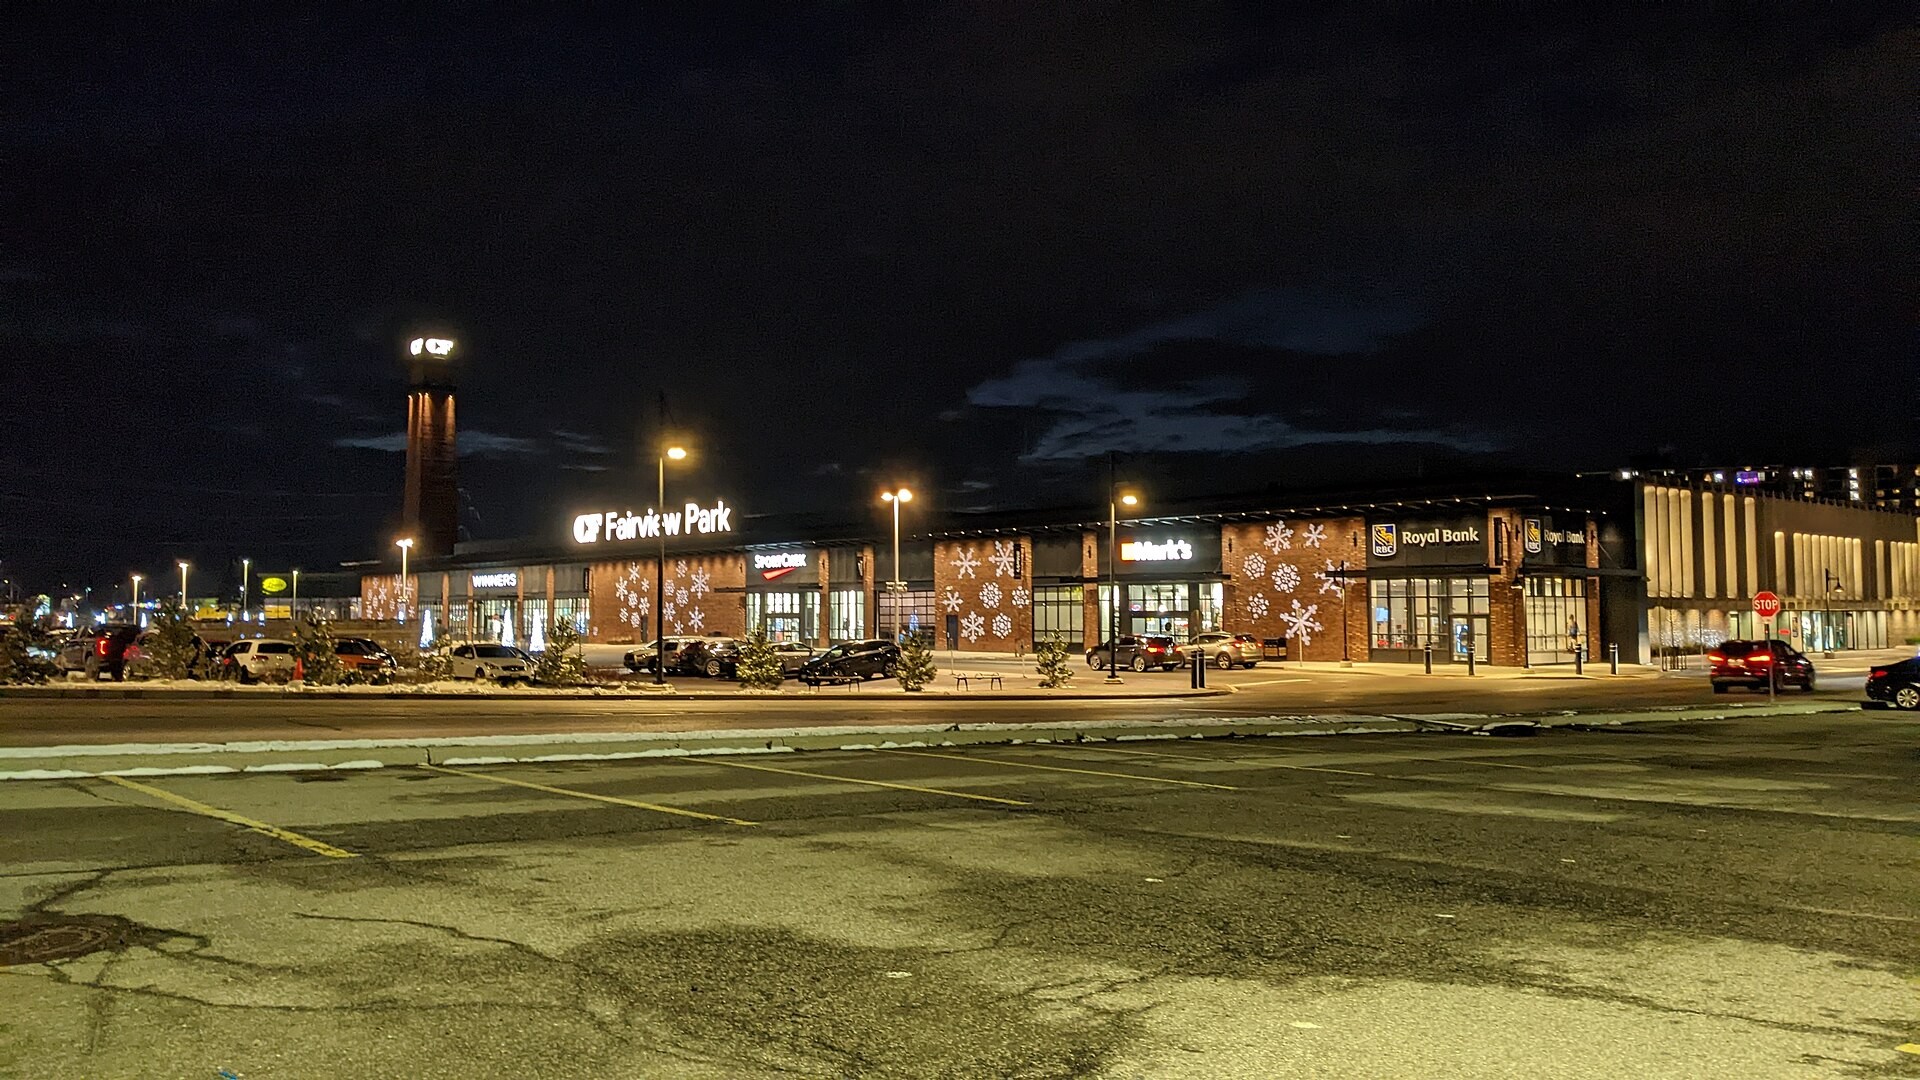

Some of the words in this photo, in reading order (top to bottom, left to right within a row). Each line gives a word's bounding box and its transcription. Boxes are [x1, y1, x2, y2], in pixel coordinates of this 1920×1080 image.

[606, 508, 682, 542] Fairview
[685, 500, 732, 535] Park
[1402, 528, 1440, 547] Royal
[1442, 526, 1479, 542] Bank
[1544, 529, 1565, 546] Royal
[1566, 530, 1585, 544] Bank
[1134, 539, 1193, 561] Mark's
[1376, 545, 1393, 554] RBC
[472, 573, 517, 588] WINNERS
[1754, 599, 1778, 610] STOP
